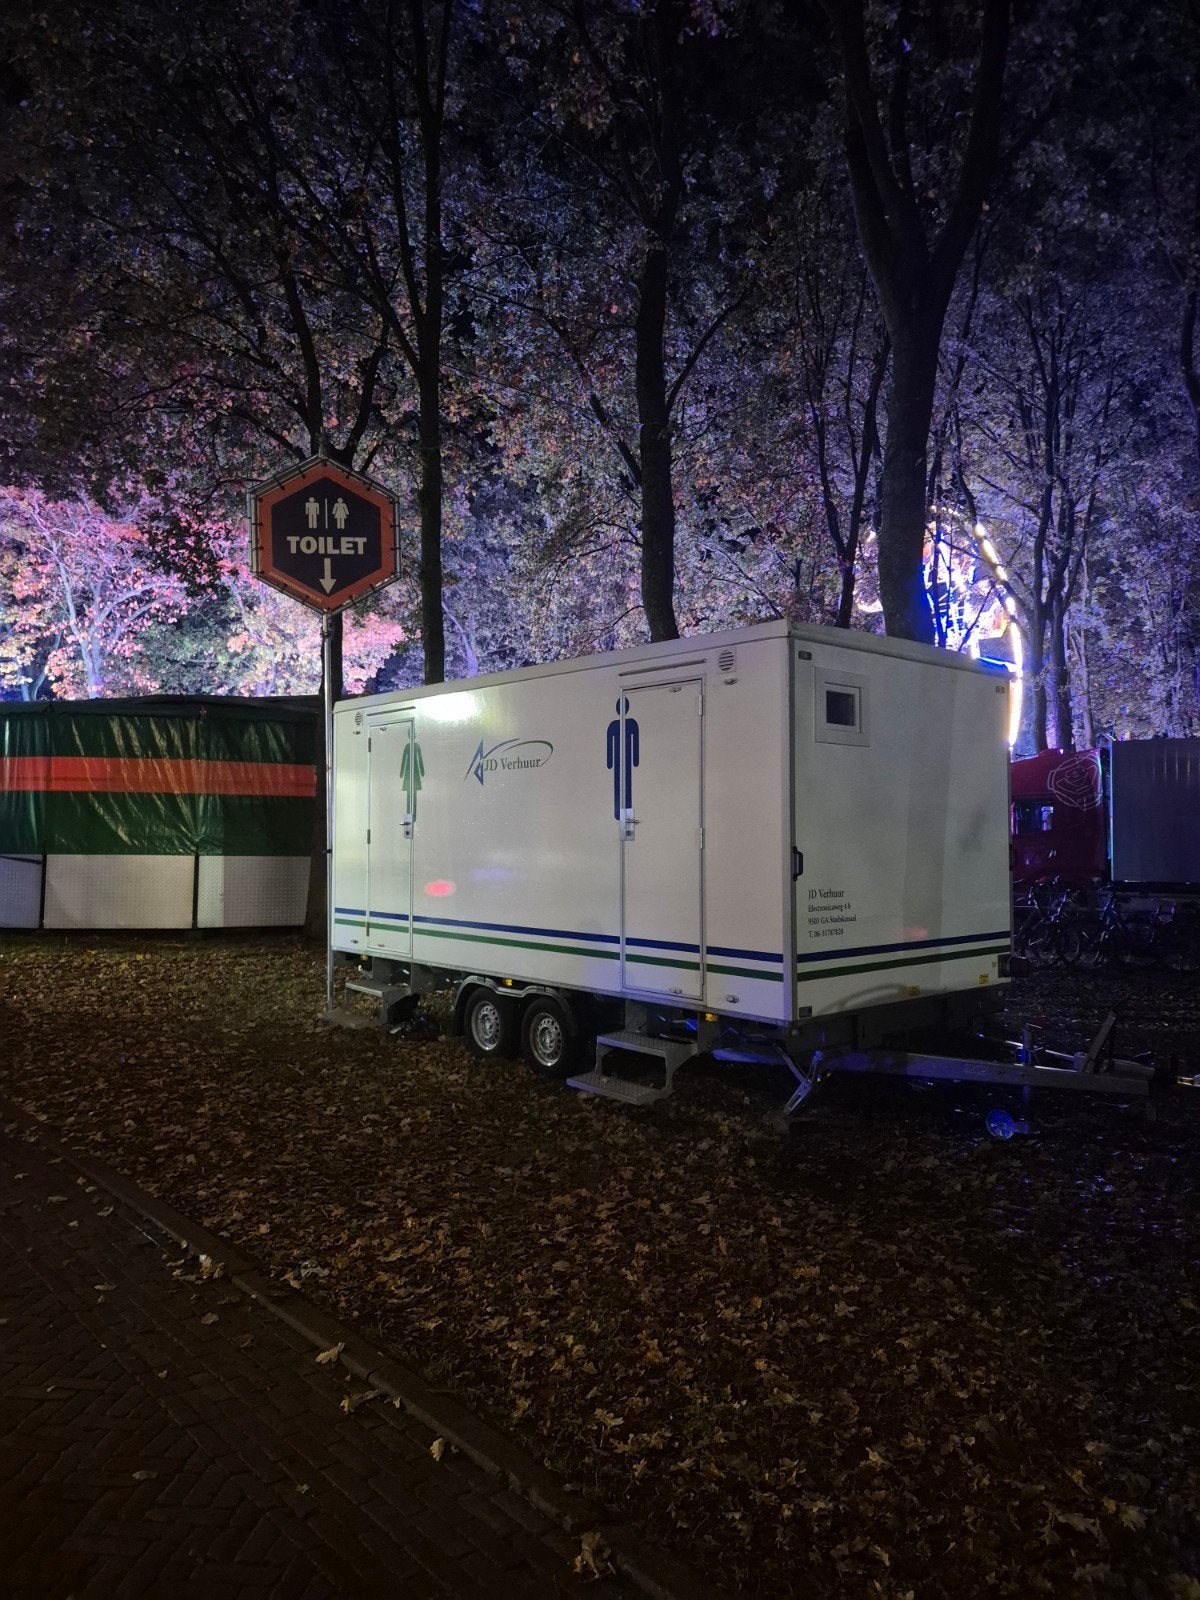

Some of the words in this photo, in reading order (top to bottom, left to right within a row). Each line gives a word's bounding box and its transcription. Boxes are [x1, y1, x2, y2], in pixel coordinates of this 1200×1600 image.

[286, 535, 367, 555] TOILET
[484, 758, 498, 772] JD
[501, 757, 541, 771] Verhuur
[808, 889, 817, 900] JD
[818, 888, 846, 899] Verhuur
